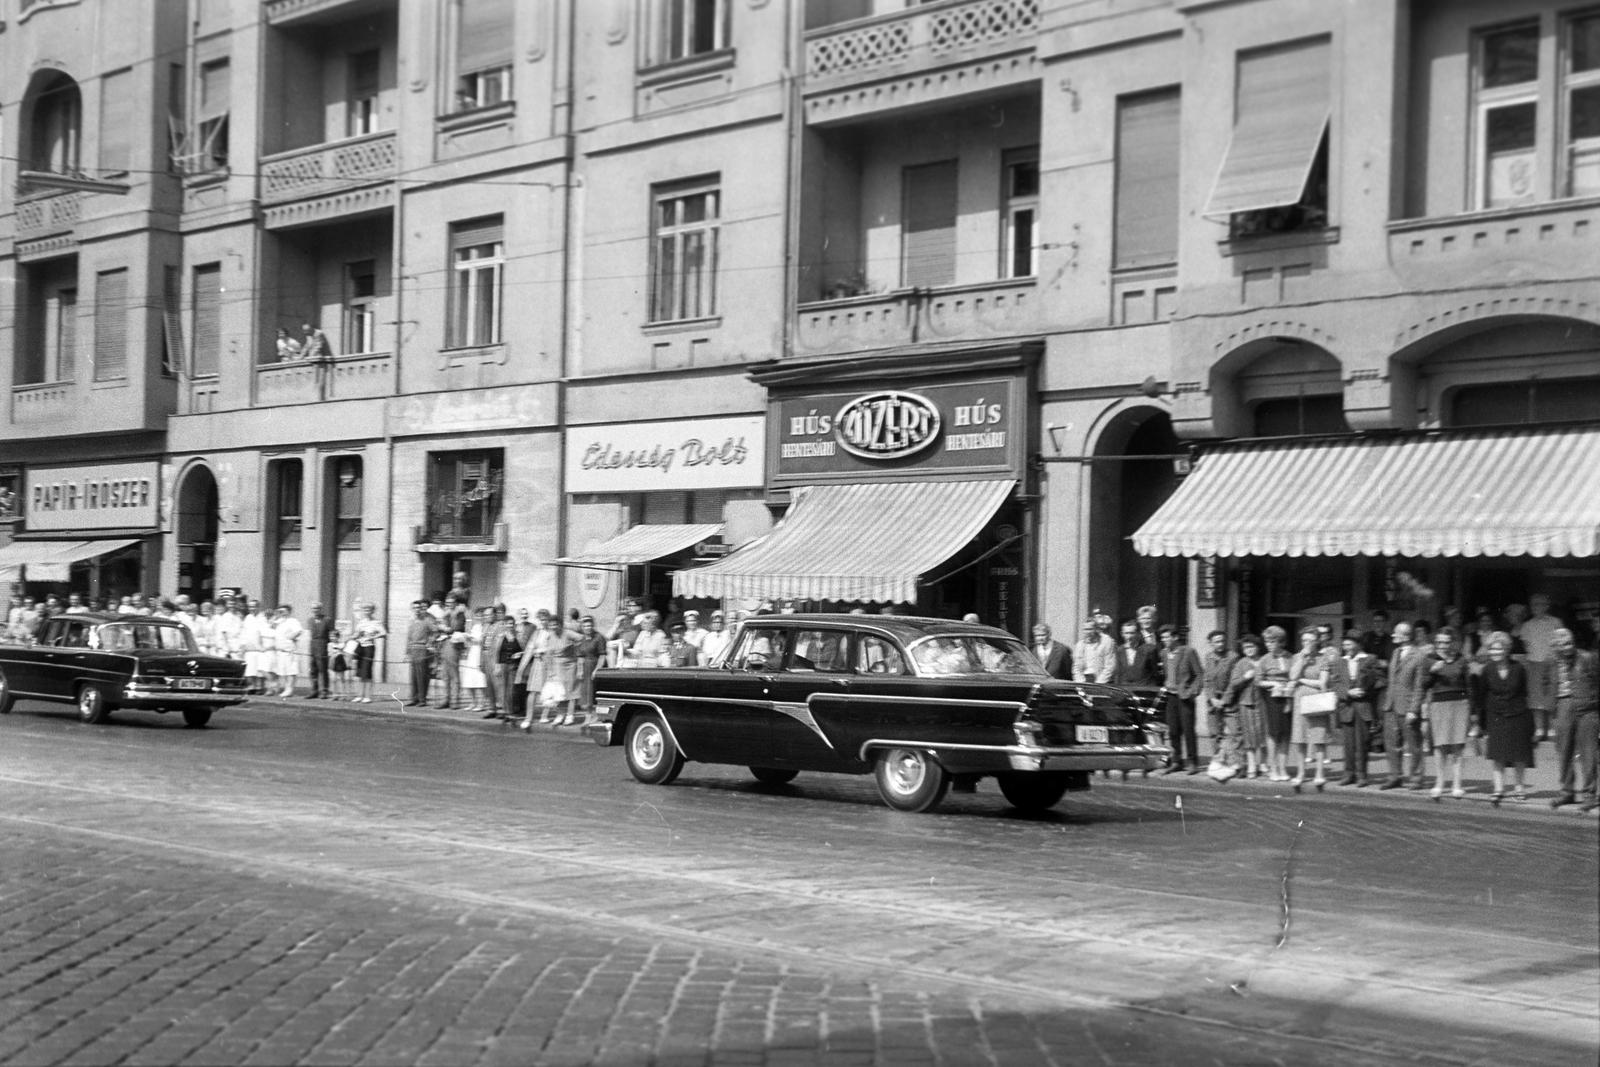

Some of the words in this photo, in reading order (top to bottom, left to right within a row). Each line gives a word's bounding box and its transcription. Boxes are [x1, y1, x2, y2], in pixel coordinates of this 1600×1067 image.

[790, 409, 832, 435] HÚS
[953, 398, 1001, 426] HÚS
[681, 437, 748, 466] Bolt
